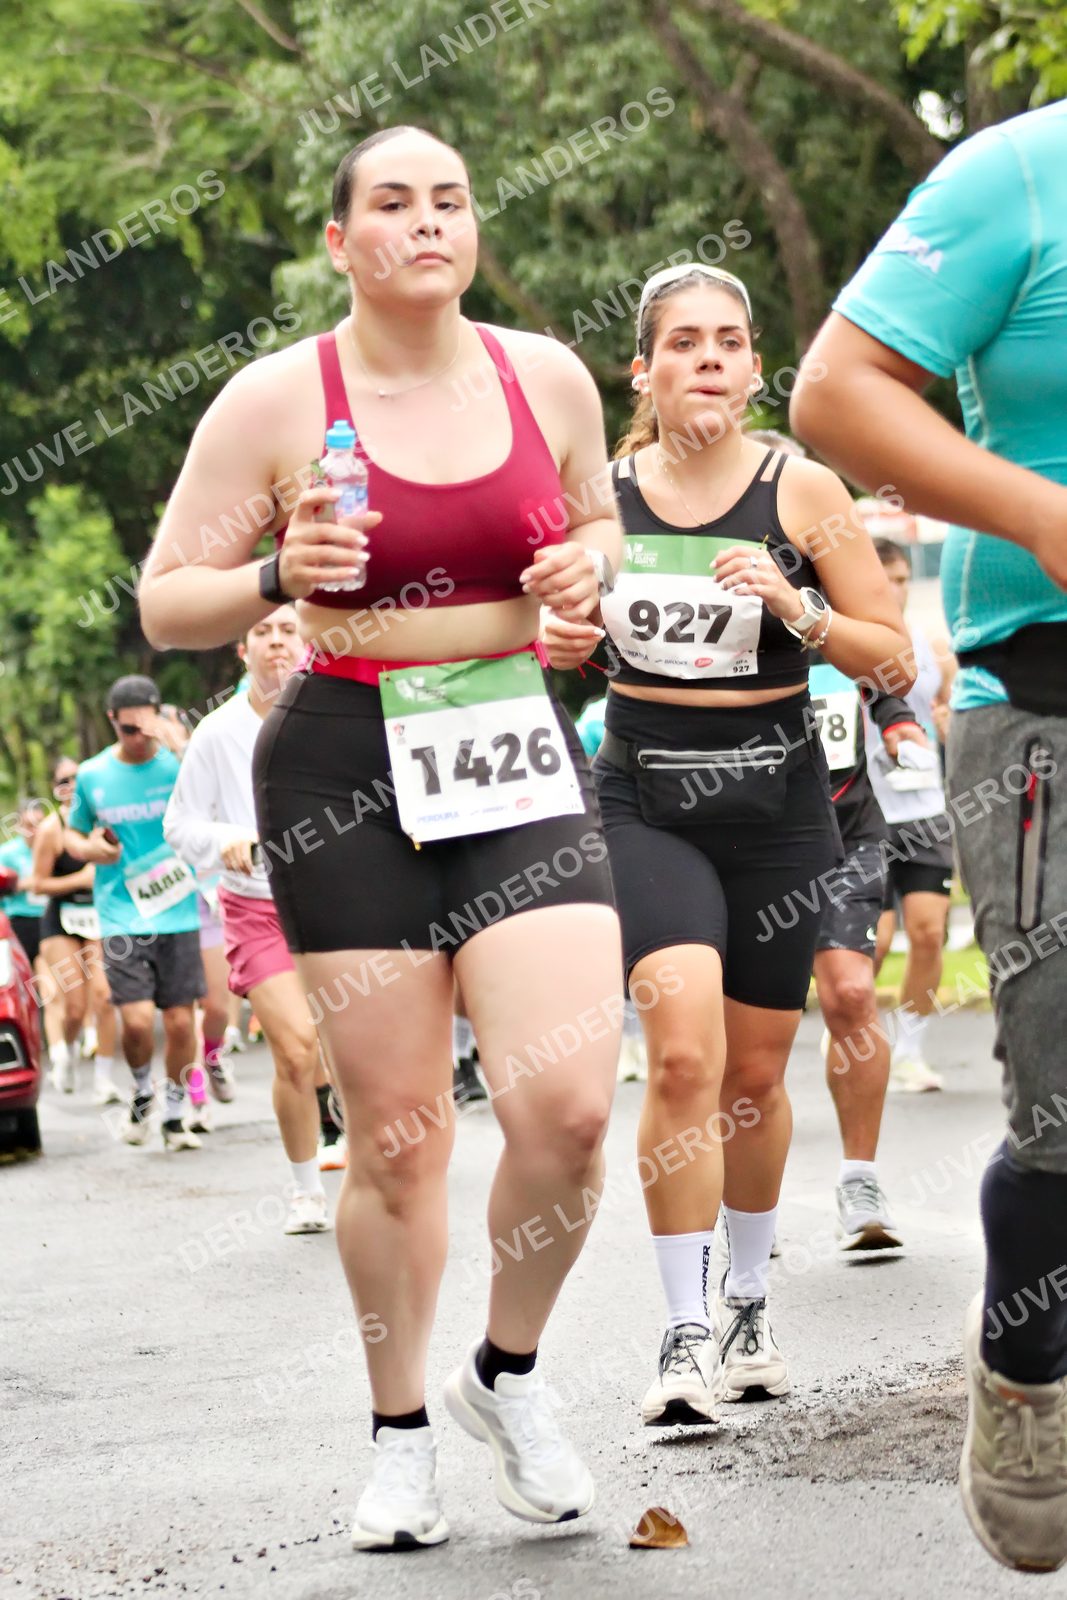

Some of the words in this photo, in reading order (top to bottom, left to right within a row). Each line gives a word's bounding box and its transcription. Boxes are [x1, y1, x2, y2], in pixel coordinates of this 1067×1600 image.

[629, 600, 732, 644] 927
[733, 665, 750, 674] 927
[410, 727, 561, 796] 1426
